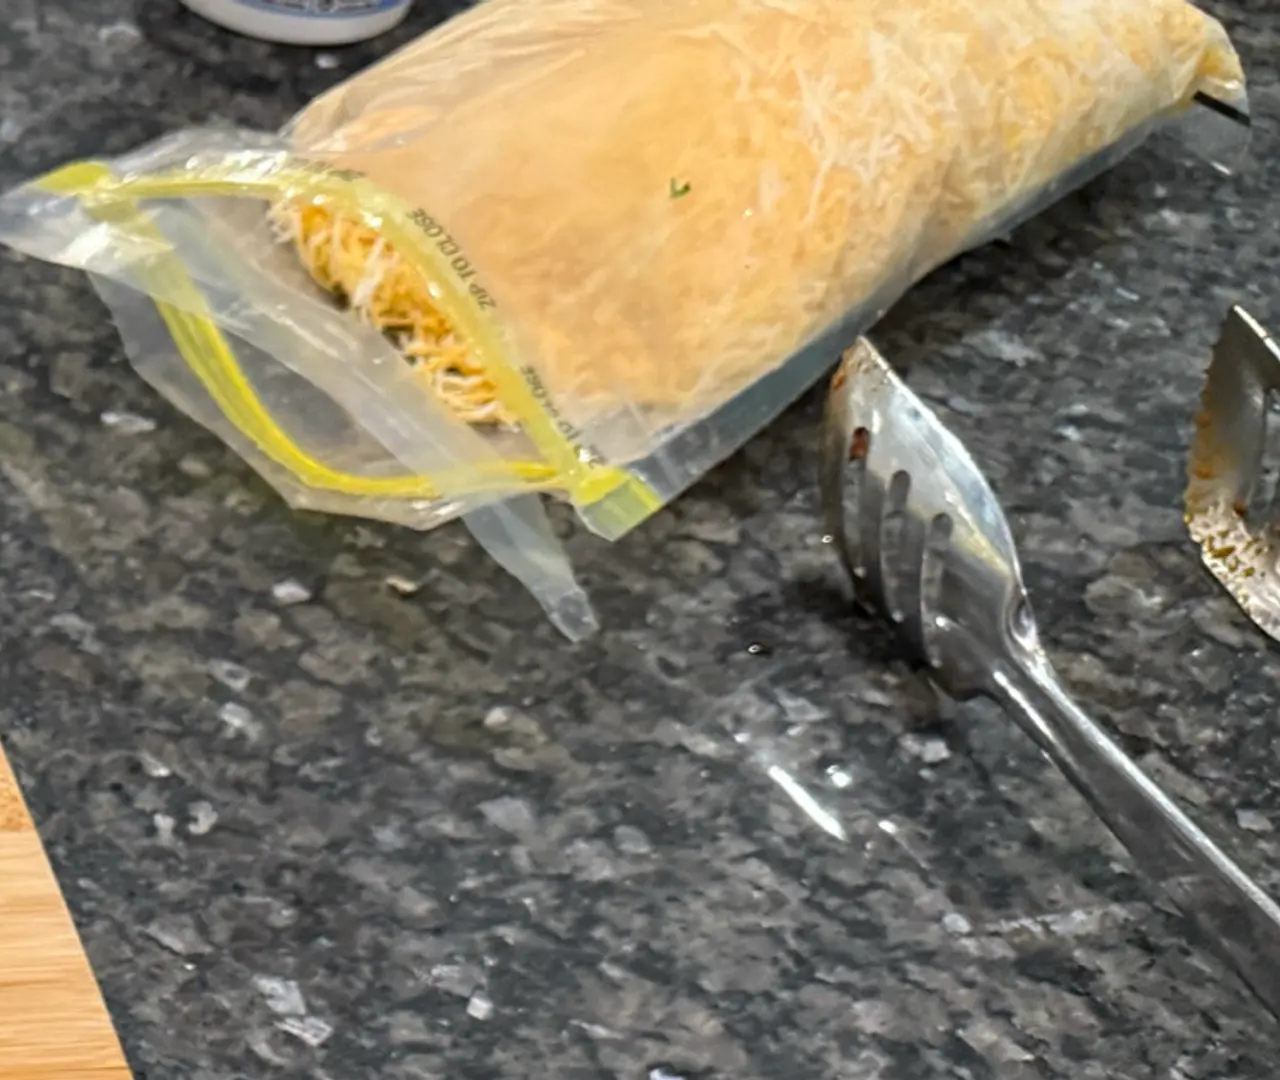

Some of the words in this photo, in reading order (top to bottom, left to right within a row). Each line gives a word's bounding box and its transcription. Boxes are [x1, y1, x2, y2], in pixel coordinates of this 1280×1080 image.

[404, 207, 461, 257] CLOSE
[450, 256, 478, 283] TO
[468, 282, 497, 312] ZIP
